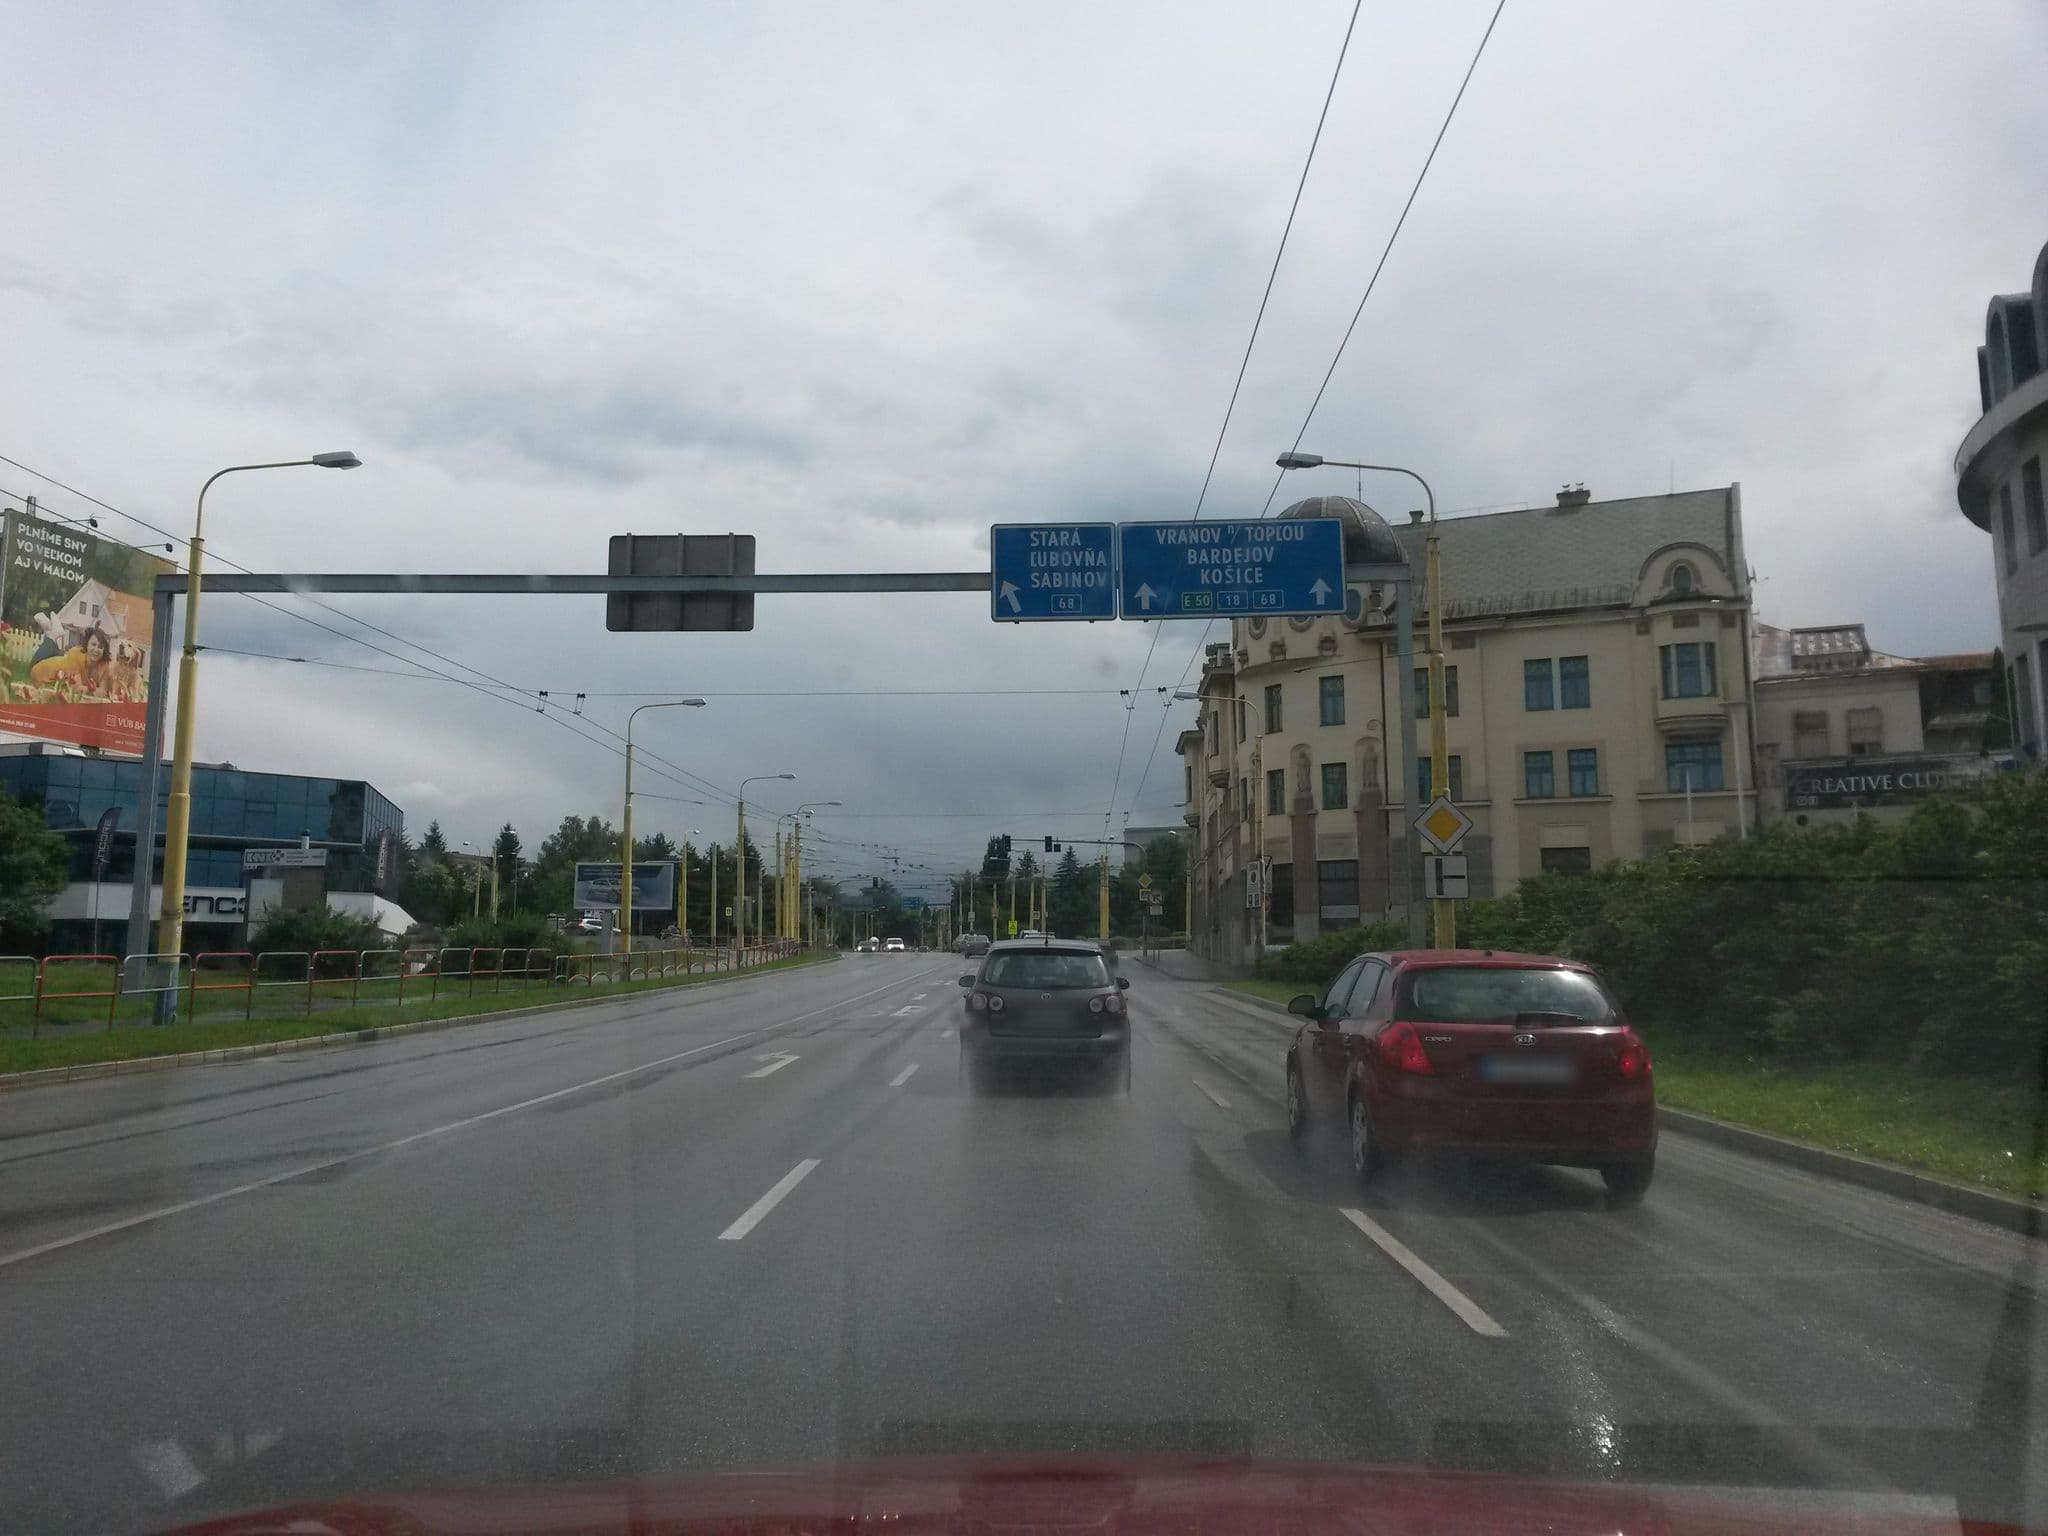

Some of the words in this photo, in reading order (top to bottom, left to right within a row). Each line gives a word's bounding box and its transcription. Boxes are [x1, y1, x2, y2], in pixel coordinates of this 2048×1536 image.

[18, 522, 62, 546] PLNÍME
[63, 537, 88, 553] SNY
[1030, 527, 1081, 547] STARÁ
[1156, 527, 1221, 545] VRANOV
[16, 538, 33, 553] VO
[36, 544, 82, 568] VEĽKOM
[1030, 547, 1108, 567] ĽUBOVŇA
[1187, 546, 1275, 565] BARDEJOV
[14, 555, 31, 568] AJ
[33, 561, 42, 571] V
[43, 563, 84, 584] MALOM
[1200, 566, 1264, 585] KOŠICE
[1031, 571, 1107, 588] SABINOV
[1058, 598, 1074, 609] 68
[1195, 594, 1210, 606] 50
[1226, 595, 1240, 606] 18
[1261, 593, 1276, 605] 68
[1796, 774, 1893, 793] CREATIVE
